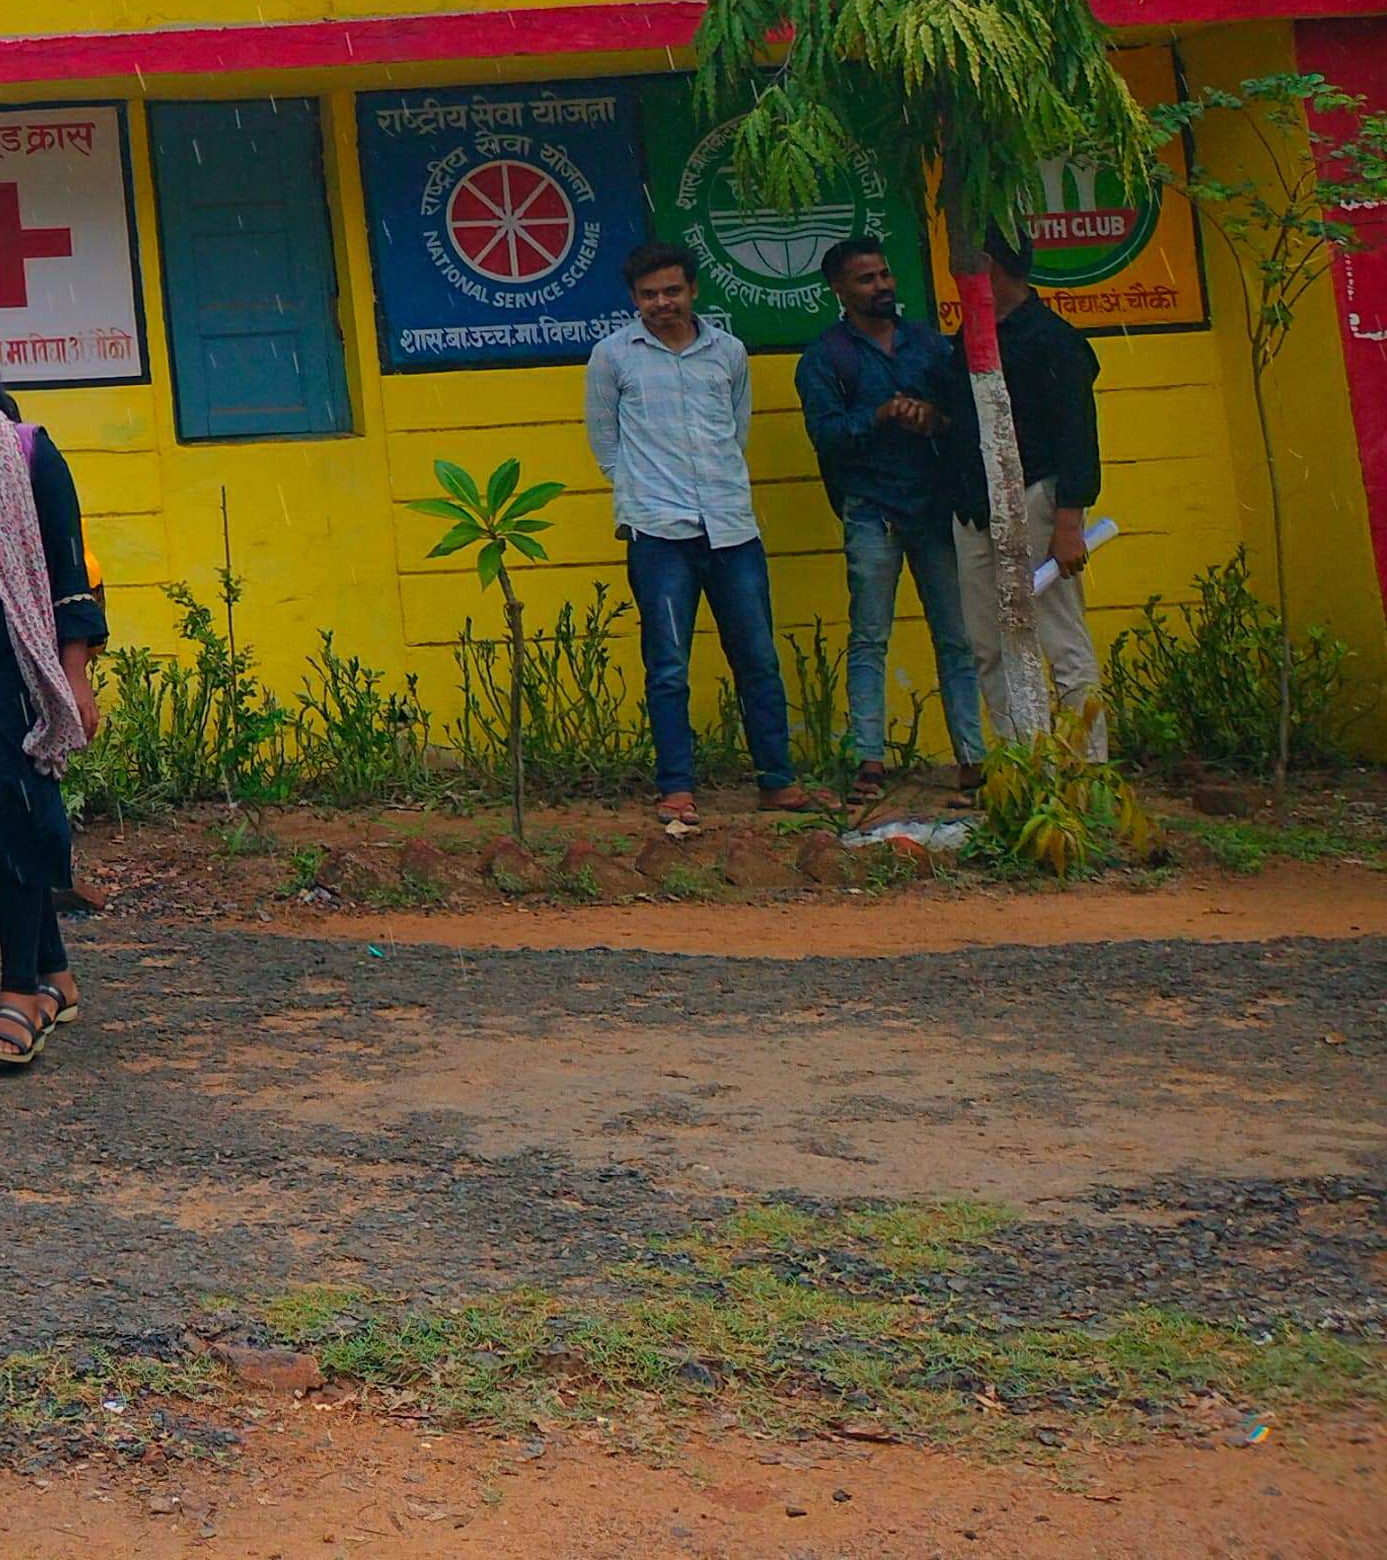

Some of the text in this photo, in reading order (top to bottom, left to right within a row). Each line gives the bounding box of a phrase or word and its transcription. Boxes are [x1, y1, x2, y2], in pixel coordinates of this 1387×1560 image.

[376, 91, 617, 137] राष्ट्रीय सेवा योजना
[26, 122, 97, 156] क्रास
[421, 125, 596, 216] राष्ट्रीय सेवा योजना
[1071, 214, 1126, 238] CLUB
[422, 221, 601, 309] NATIONAL SERVICE SCHEME
